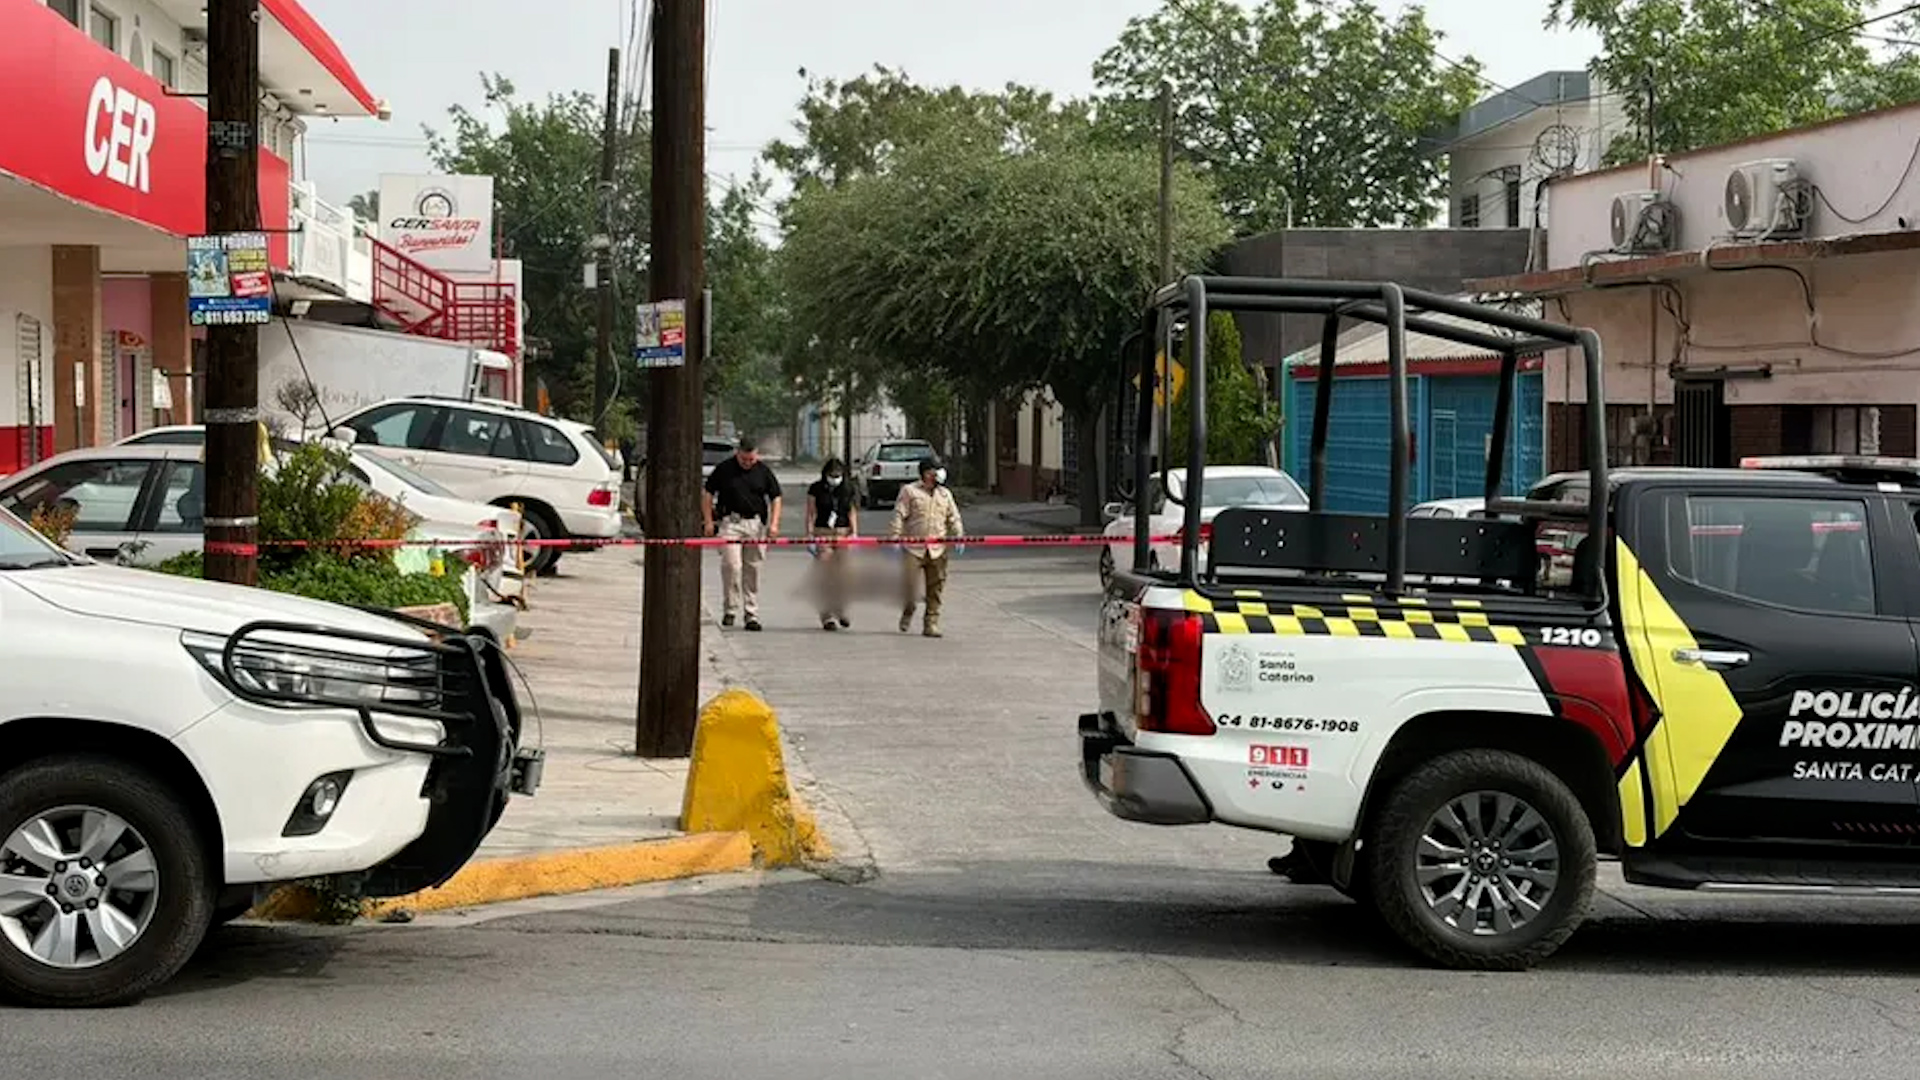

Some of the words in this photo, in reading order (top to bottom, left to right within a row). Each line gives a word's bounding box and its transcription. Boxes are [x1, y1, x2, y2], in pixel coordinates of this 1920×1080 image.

[85, 76, 155, 193] CER
[391, 217, 480, 231] CERSANTA
[205, 311, 222, 324] 811
[223, 310, 243, 324] 693
[245, 310, 269, 323] 7245
[1540, 626, 1602, 647] 1210
[1259, 660, 1295, 669] Santa
[1259, 672, 1314, 682] Catarina
[1218, 714, 1241, 726] C4
[1250, 715, 1360, 732] 81-8676-1908
[1779, 720, 1920, 750] PROXIMI
[1252, 747, 1303, 764] 911
[1793, 761, 1863, 780] SANTA
